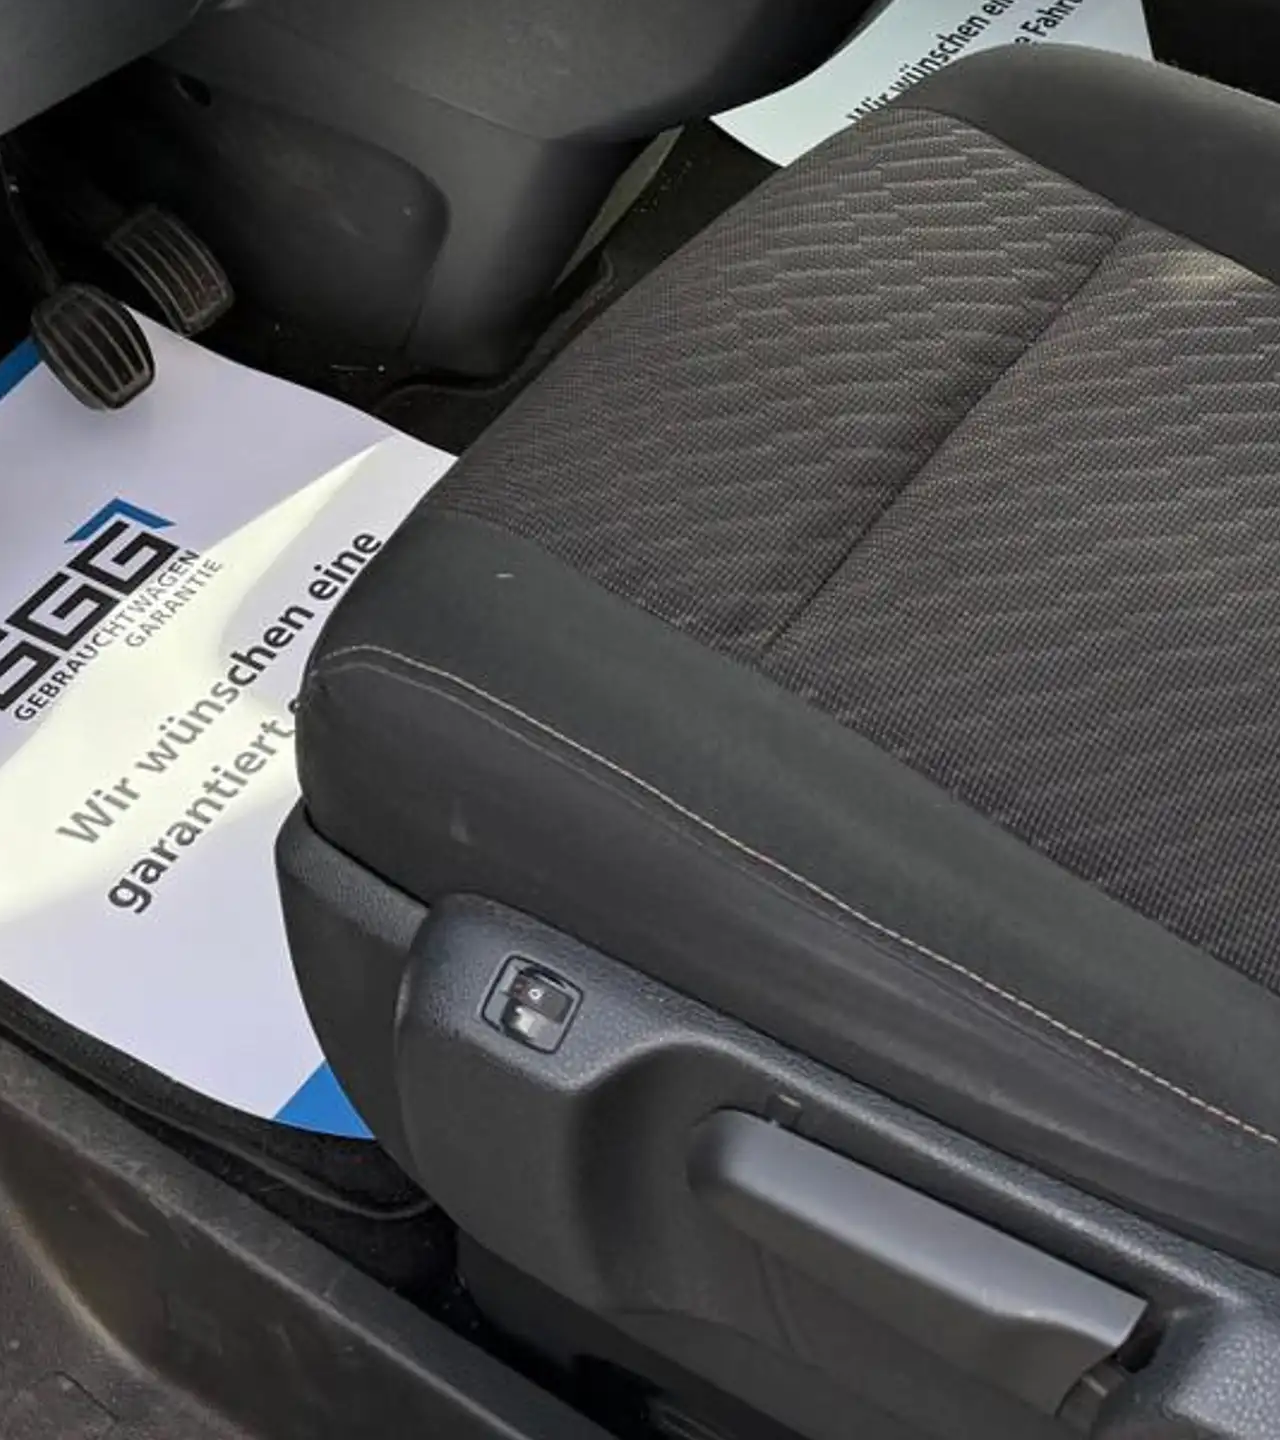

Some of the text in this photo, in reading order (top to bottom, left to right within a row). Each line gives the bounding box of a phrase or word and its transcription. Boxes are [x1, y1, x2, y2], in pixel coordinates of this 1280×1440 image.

[888, 15, 991, 96] wünschen
[13, 548, 200, 722] GEBRAUCHTWAGEN
[54, 532, 383, 844] Wir wünschen eine
[124, 558, 223, 649] GARANTIE
[107, 718, 296, 915] garantiert
